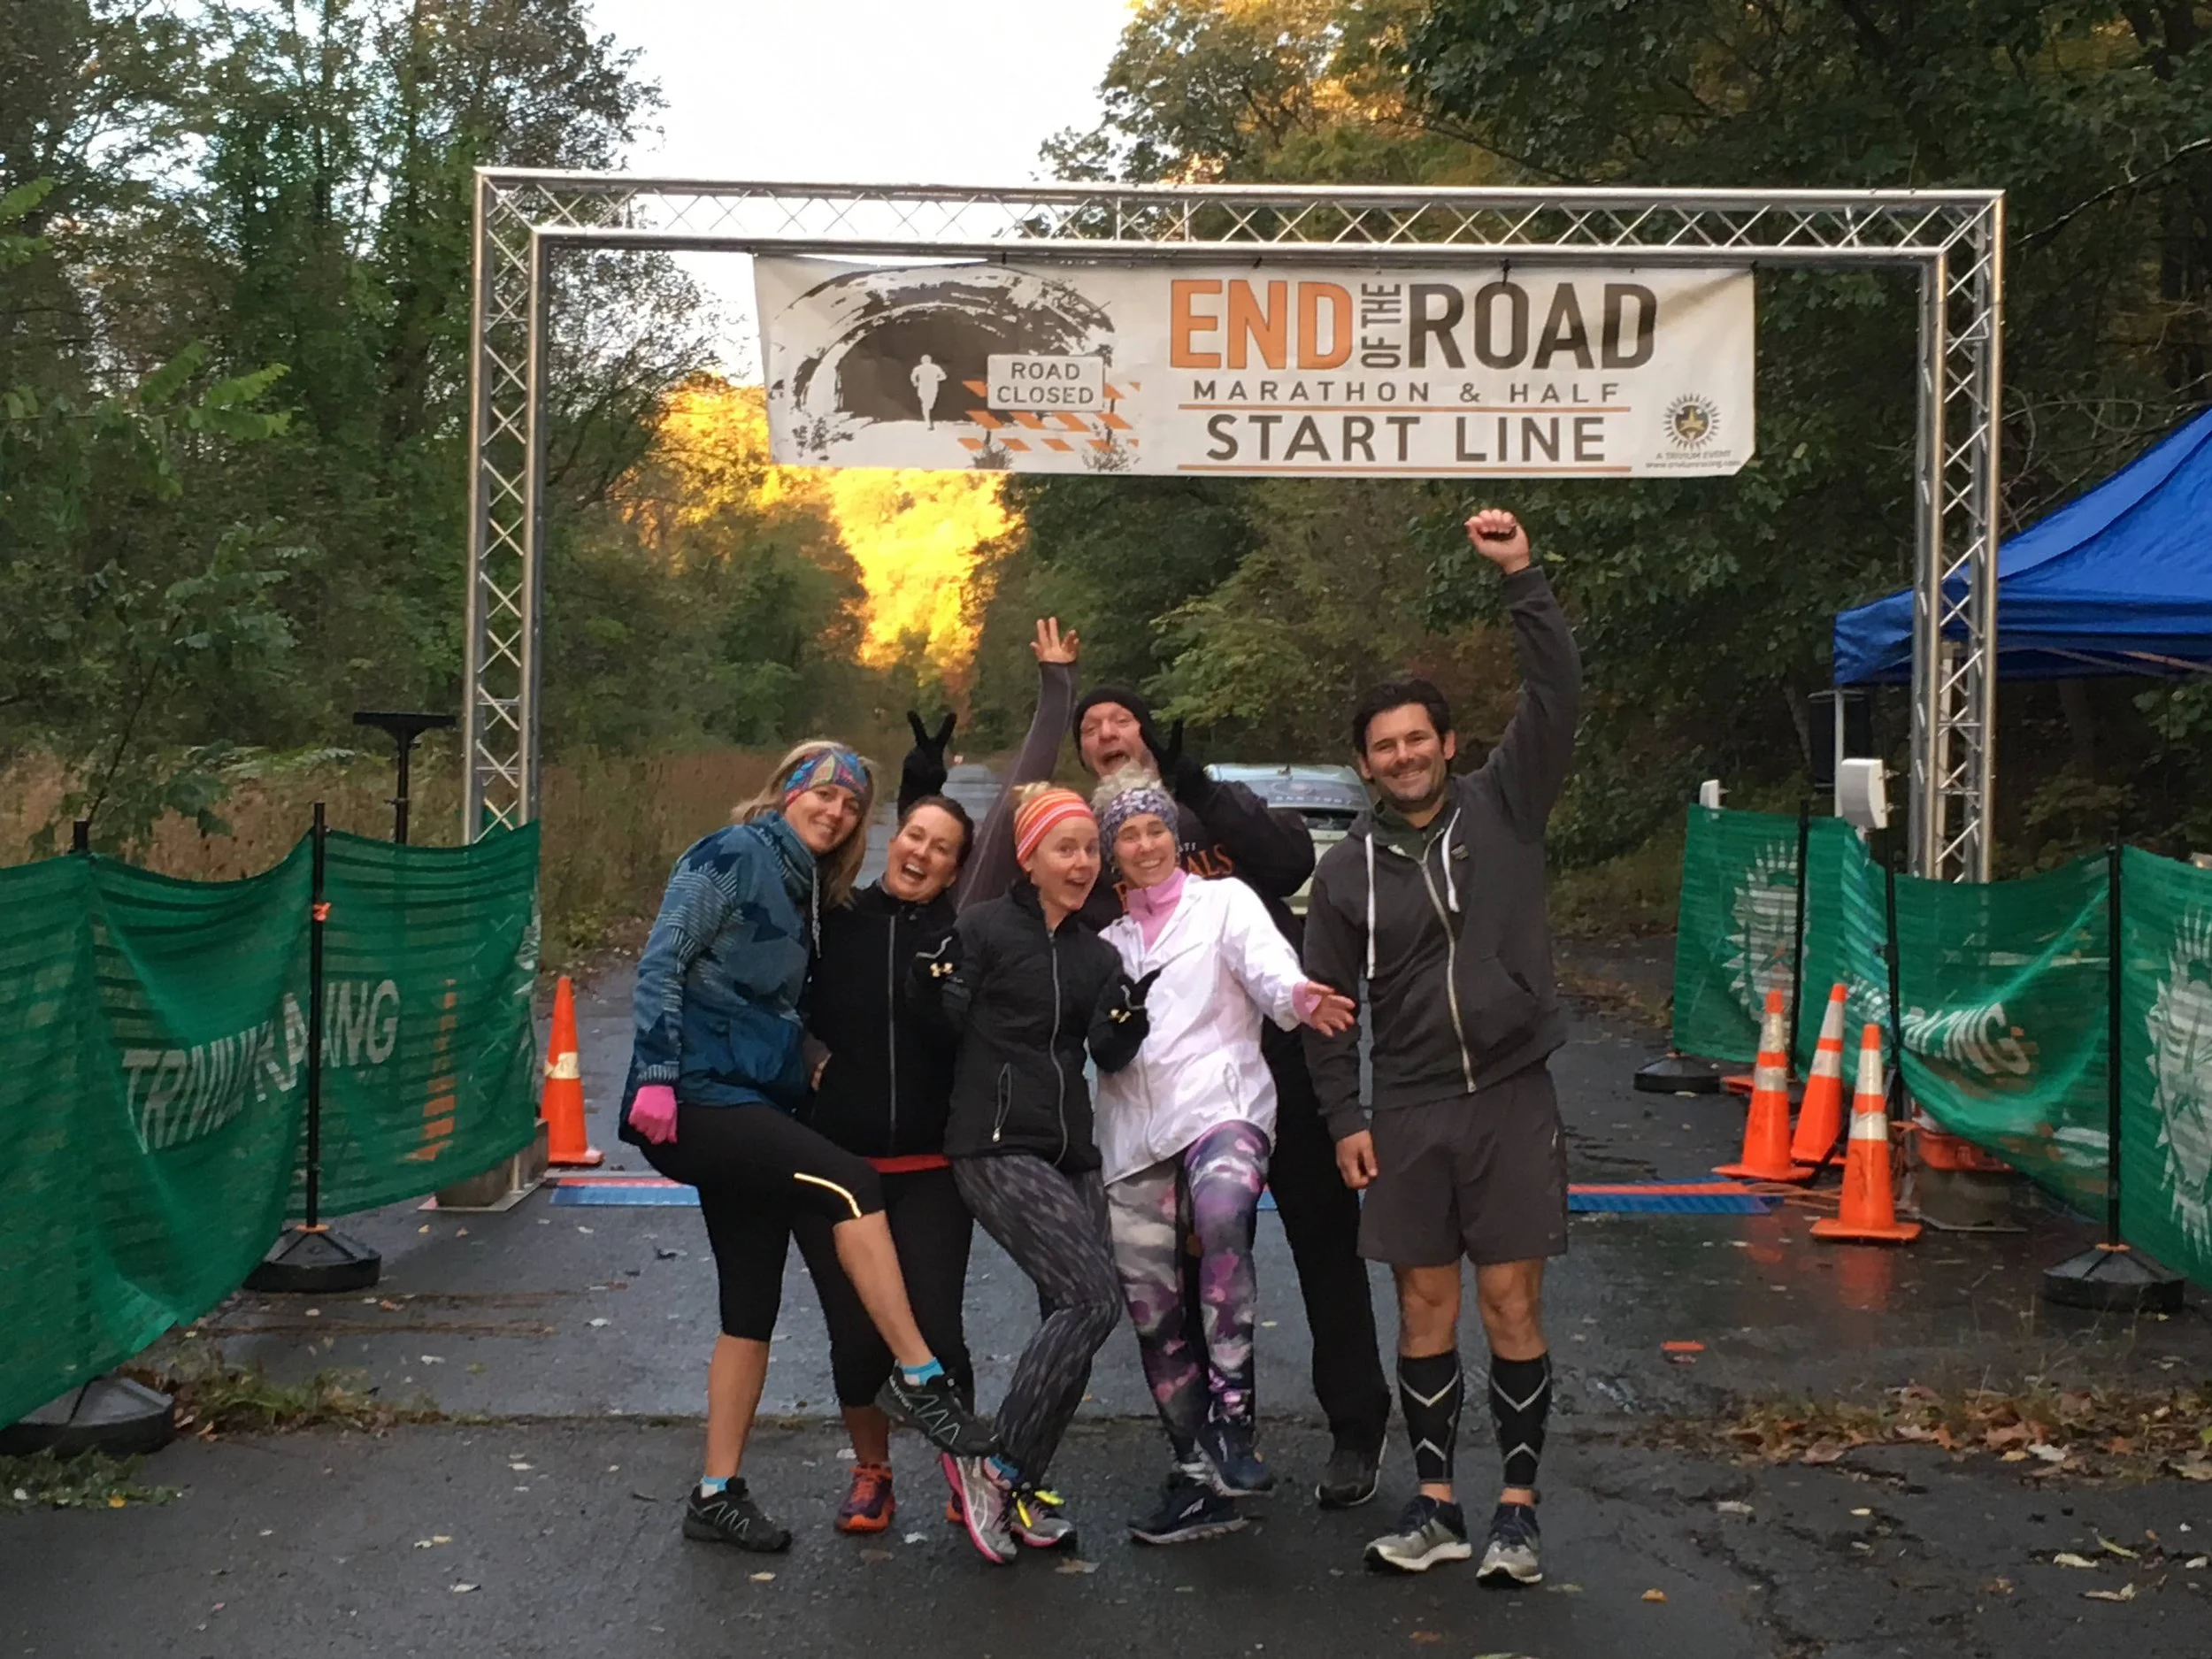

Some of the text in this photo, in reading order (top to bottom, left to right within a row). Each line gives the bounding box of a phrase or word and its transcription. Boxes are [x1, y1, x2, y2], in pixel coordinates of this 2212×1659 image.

[1170, 280, 1354, 370] END
[1360, 282, 1402, 369] OF THE
[1409, 281, 1657, 370] ROAD
[996, 385, 1094, 404] CLOSED
[1010, 361, 1080, 380] ROAD
[1194, 380, 1619, 403] MARATHON & HALF
[1206, 413, 1605, 463] START LINE
